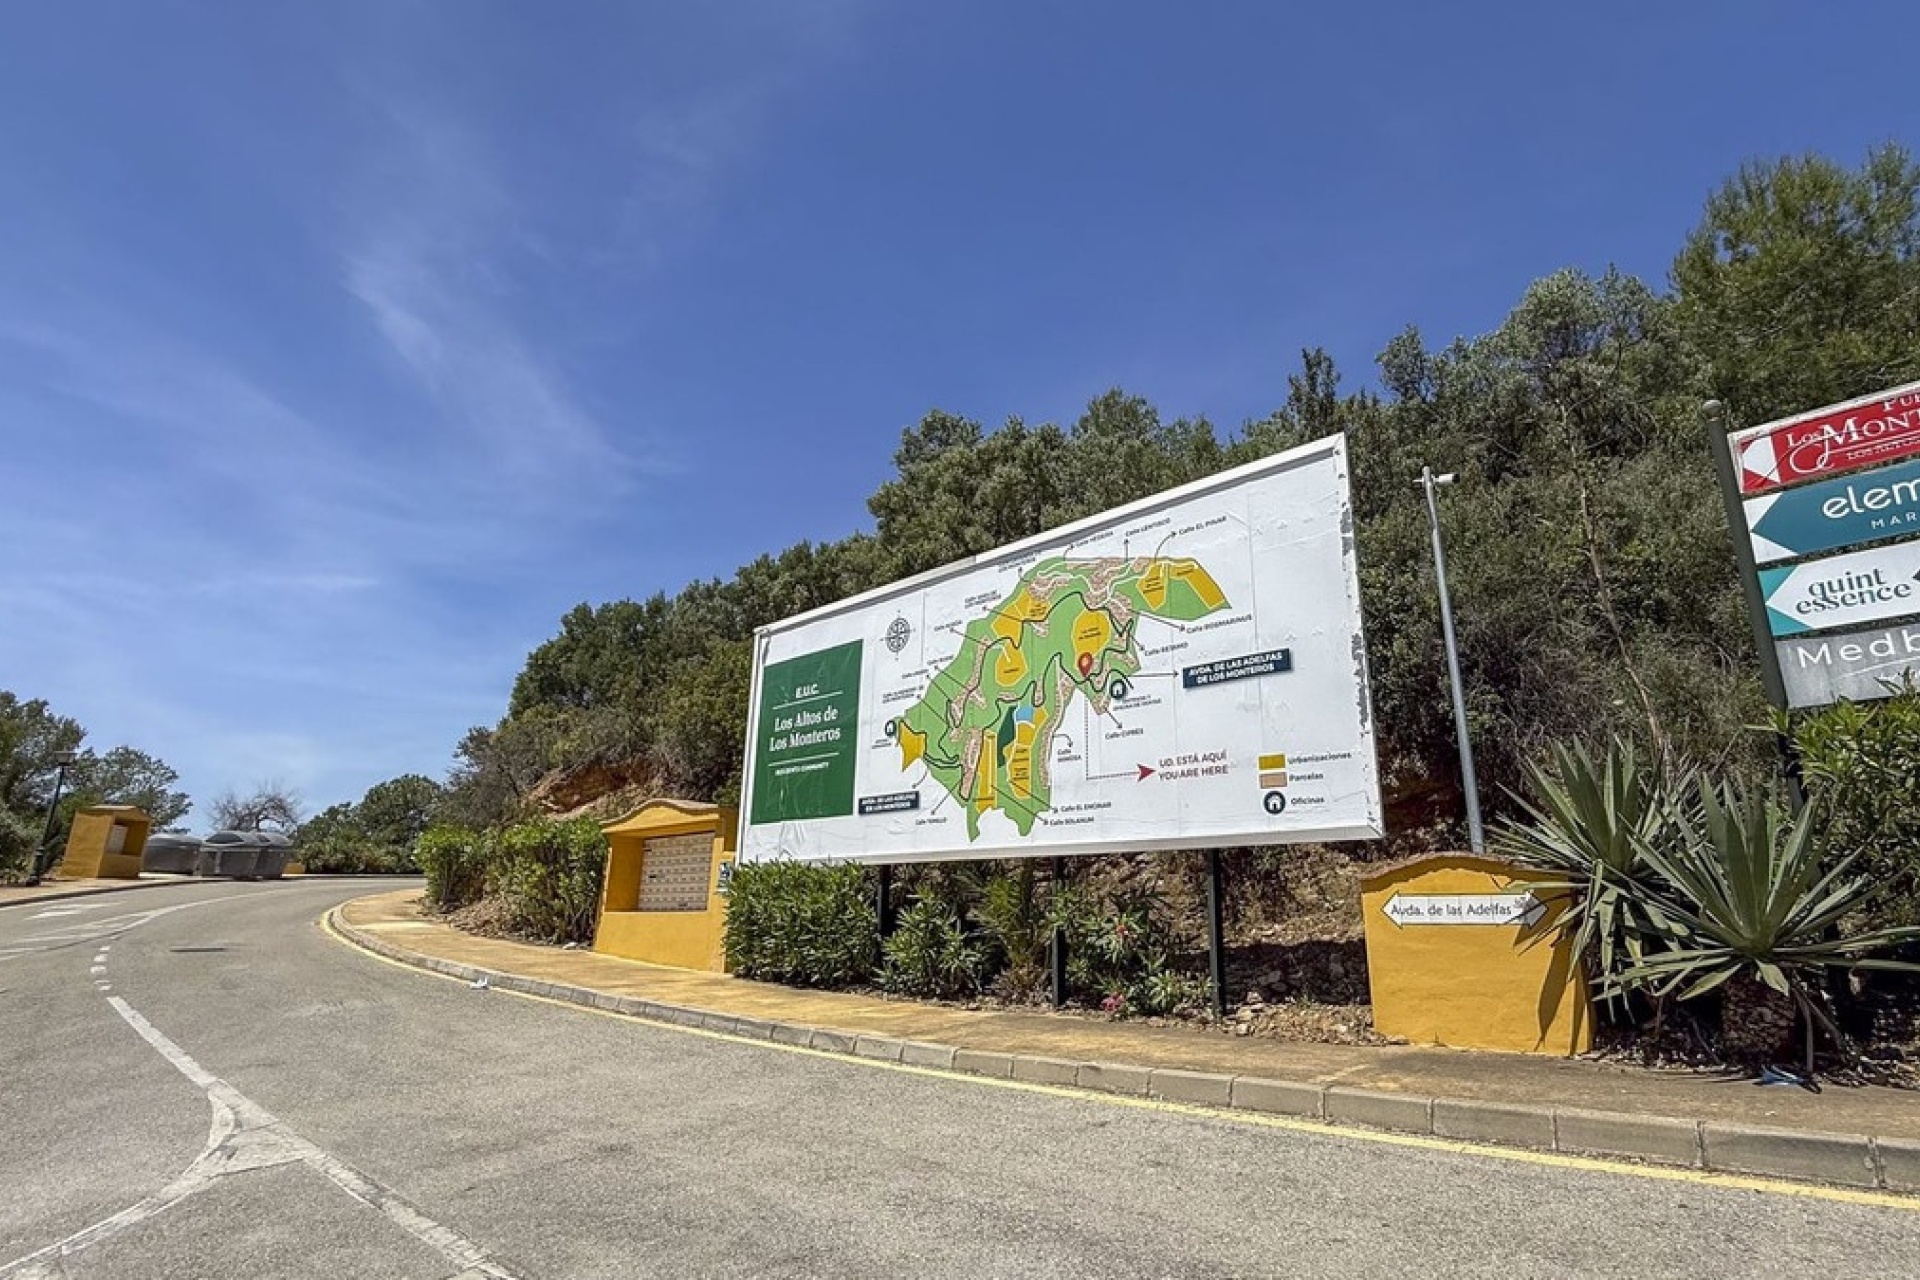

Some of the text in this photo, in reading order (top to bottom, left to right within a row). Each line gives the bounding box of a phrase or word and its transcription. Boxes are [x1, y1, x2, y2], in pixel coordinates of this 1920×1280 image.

[1871, 511, 1917, 529] MAR
[1808, 568, 1887, 600] quint
[1796, 583, 1911, 614] essence
[1197, 662, 1275, 684] DE LOS MONTEROS
[1213, 662, 1225, 672] DE
[1226, 659, 1243, 669] LAS
[774, 705, 838, 732] Los Altos de
[769, 727, 841, 751] Los Monteros
[1288, 751, 1352, 764] Urbanizaciones
[1159, 764, 1229, 781] YOU ARE HERE
[1289, 772, 1323, 782] Parcelas
[1291, 796, 1325, 805] Oficinas
[1391, 902, 1512, 916] Avda. de las Adelfas
